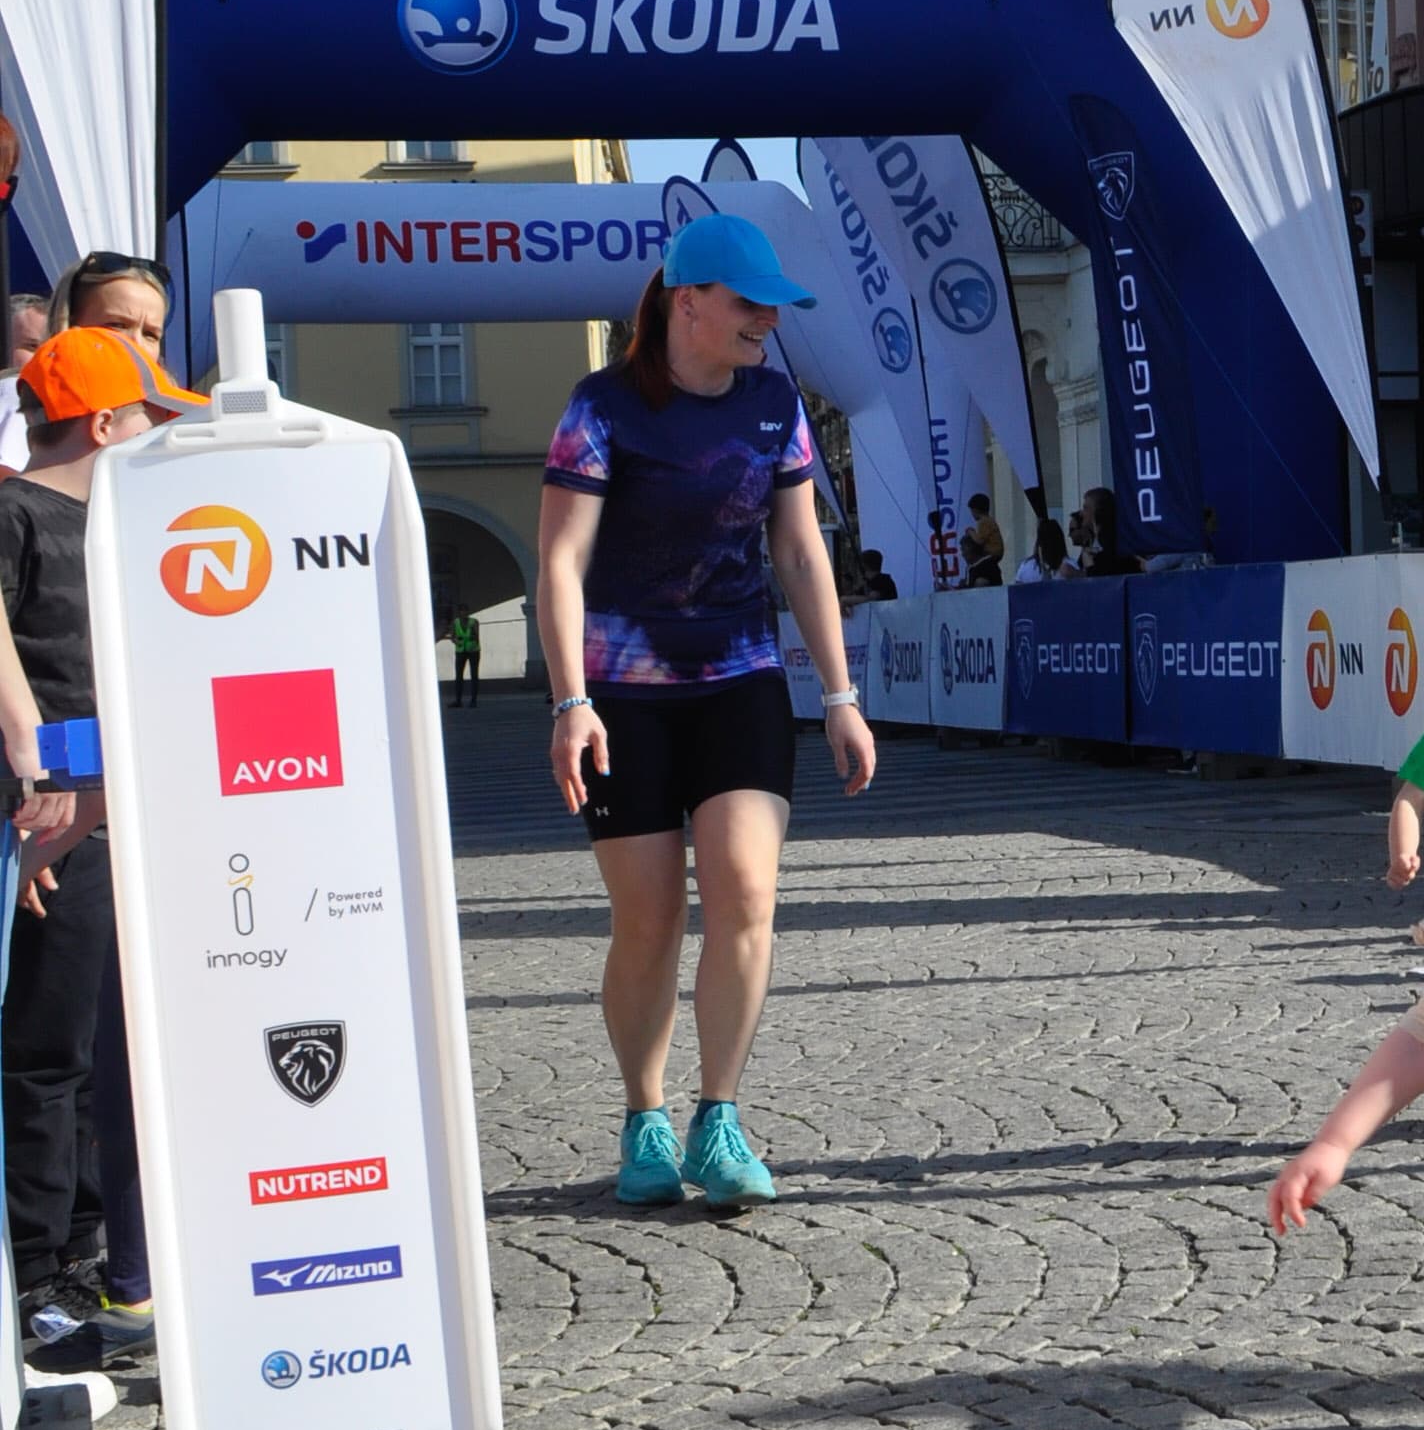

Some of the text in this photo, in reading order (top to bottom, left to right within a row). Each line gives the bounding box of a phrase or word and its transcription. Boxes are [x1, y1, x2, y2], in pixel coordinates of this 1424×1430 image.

[1110, 236, 1162, 522] PEUGEOT
[292, 533, 370, 571] NN
[954, 629, 997, 683] ŠKODA
[1038, 643, 1121, 673] PEUGEOT
[1162, 642, 1279, 677] PEUGEOT
[1339, 643, 1364, 675] NN
[232, 755, 329, 785] AVON
[327, 887, 383, 902] Powered
[328, 901, 384, 918] by MVM
[206, 948, 288, 969] innogy
[271, 1026, 339, 1042] PEUGEOT
[257, 1165, 382, 1198] NUTREND
[308, 1343, 412, 1379] ŠKODA
